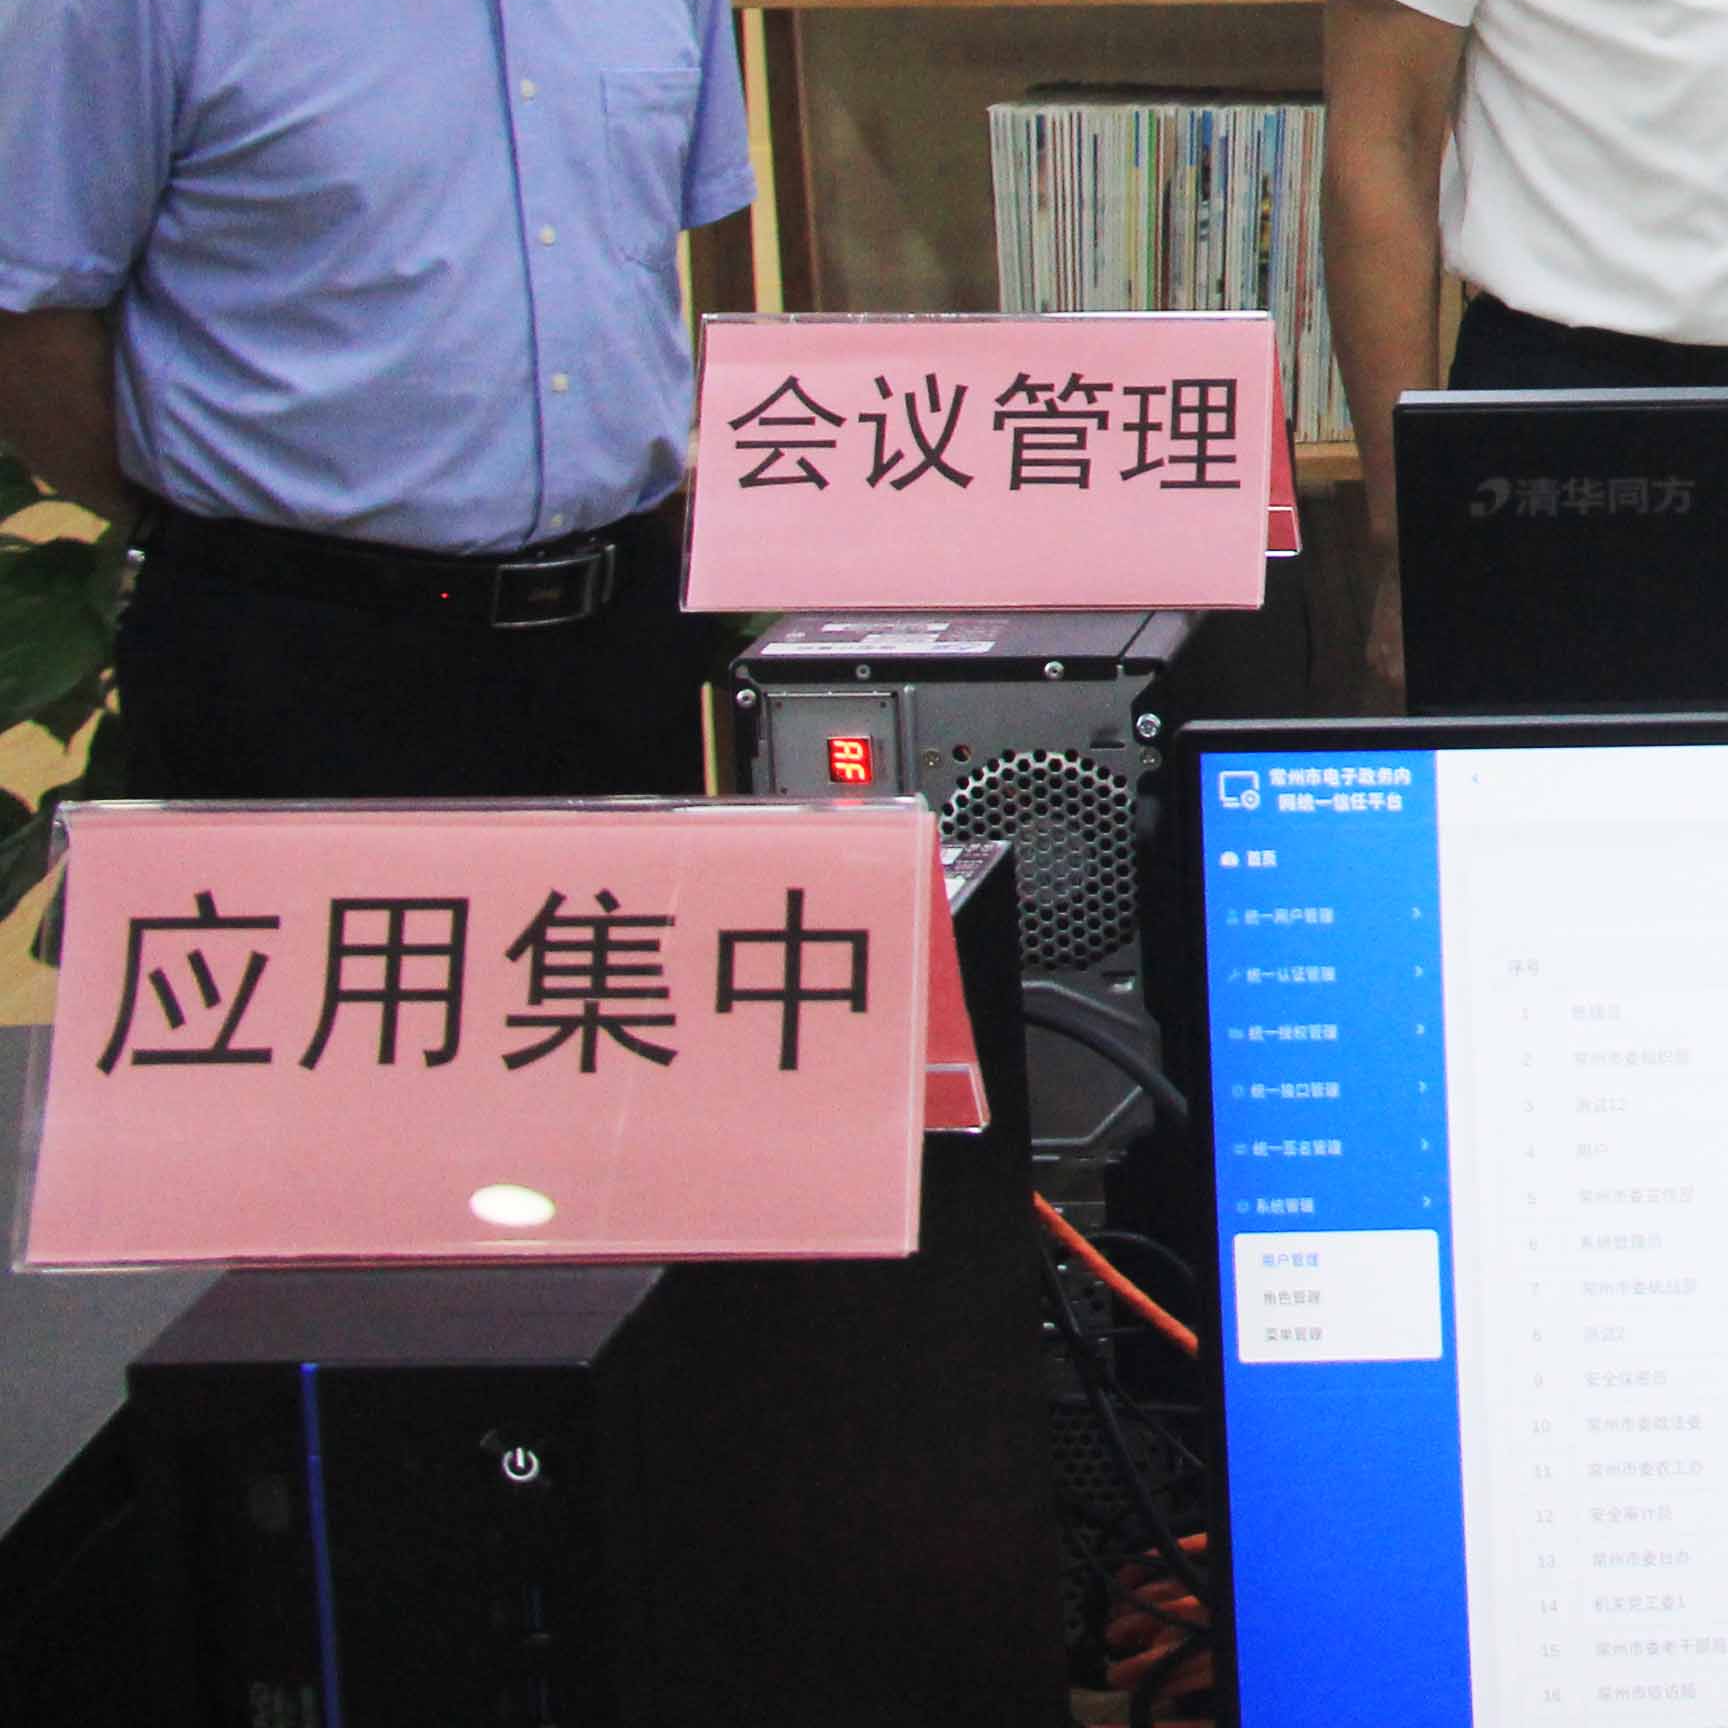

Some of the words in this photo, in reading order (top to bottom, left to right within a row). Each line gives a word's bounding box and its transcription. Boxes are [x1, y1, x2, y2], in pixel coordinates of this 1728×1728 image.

[727, 372, 1242, 493] 会议管理
[1514, 476, 1697, 518] 清华同方
[95, 886, 872, 1075] 应用集中
